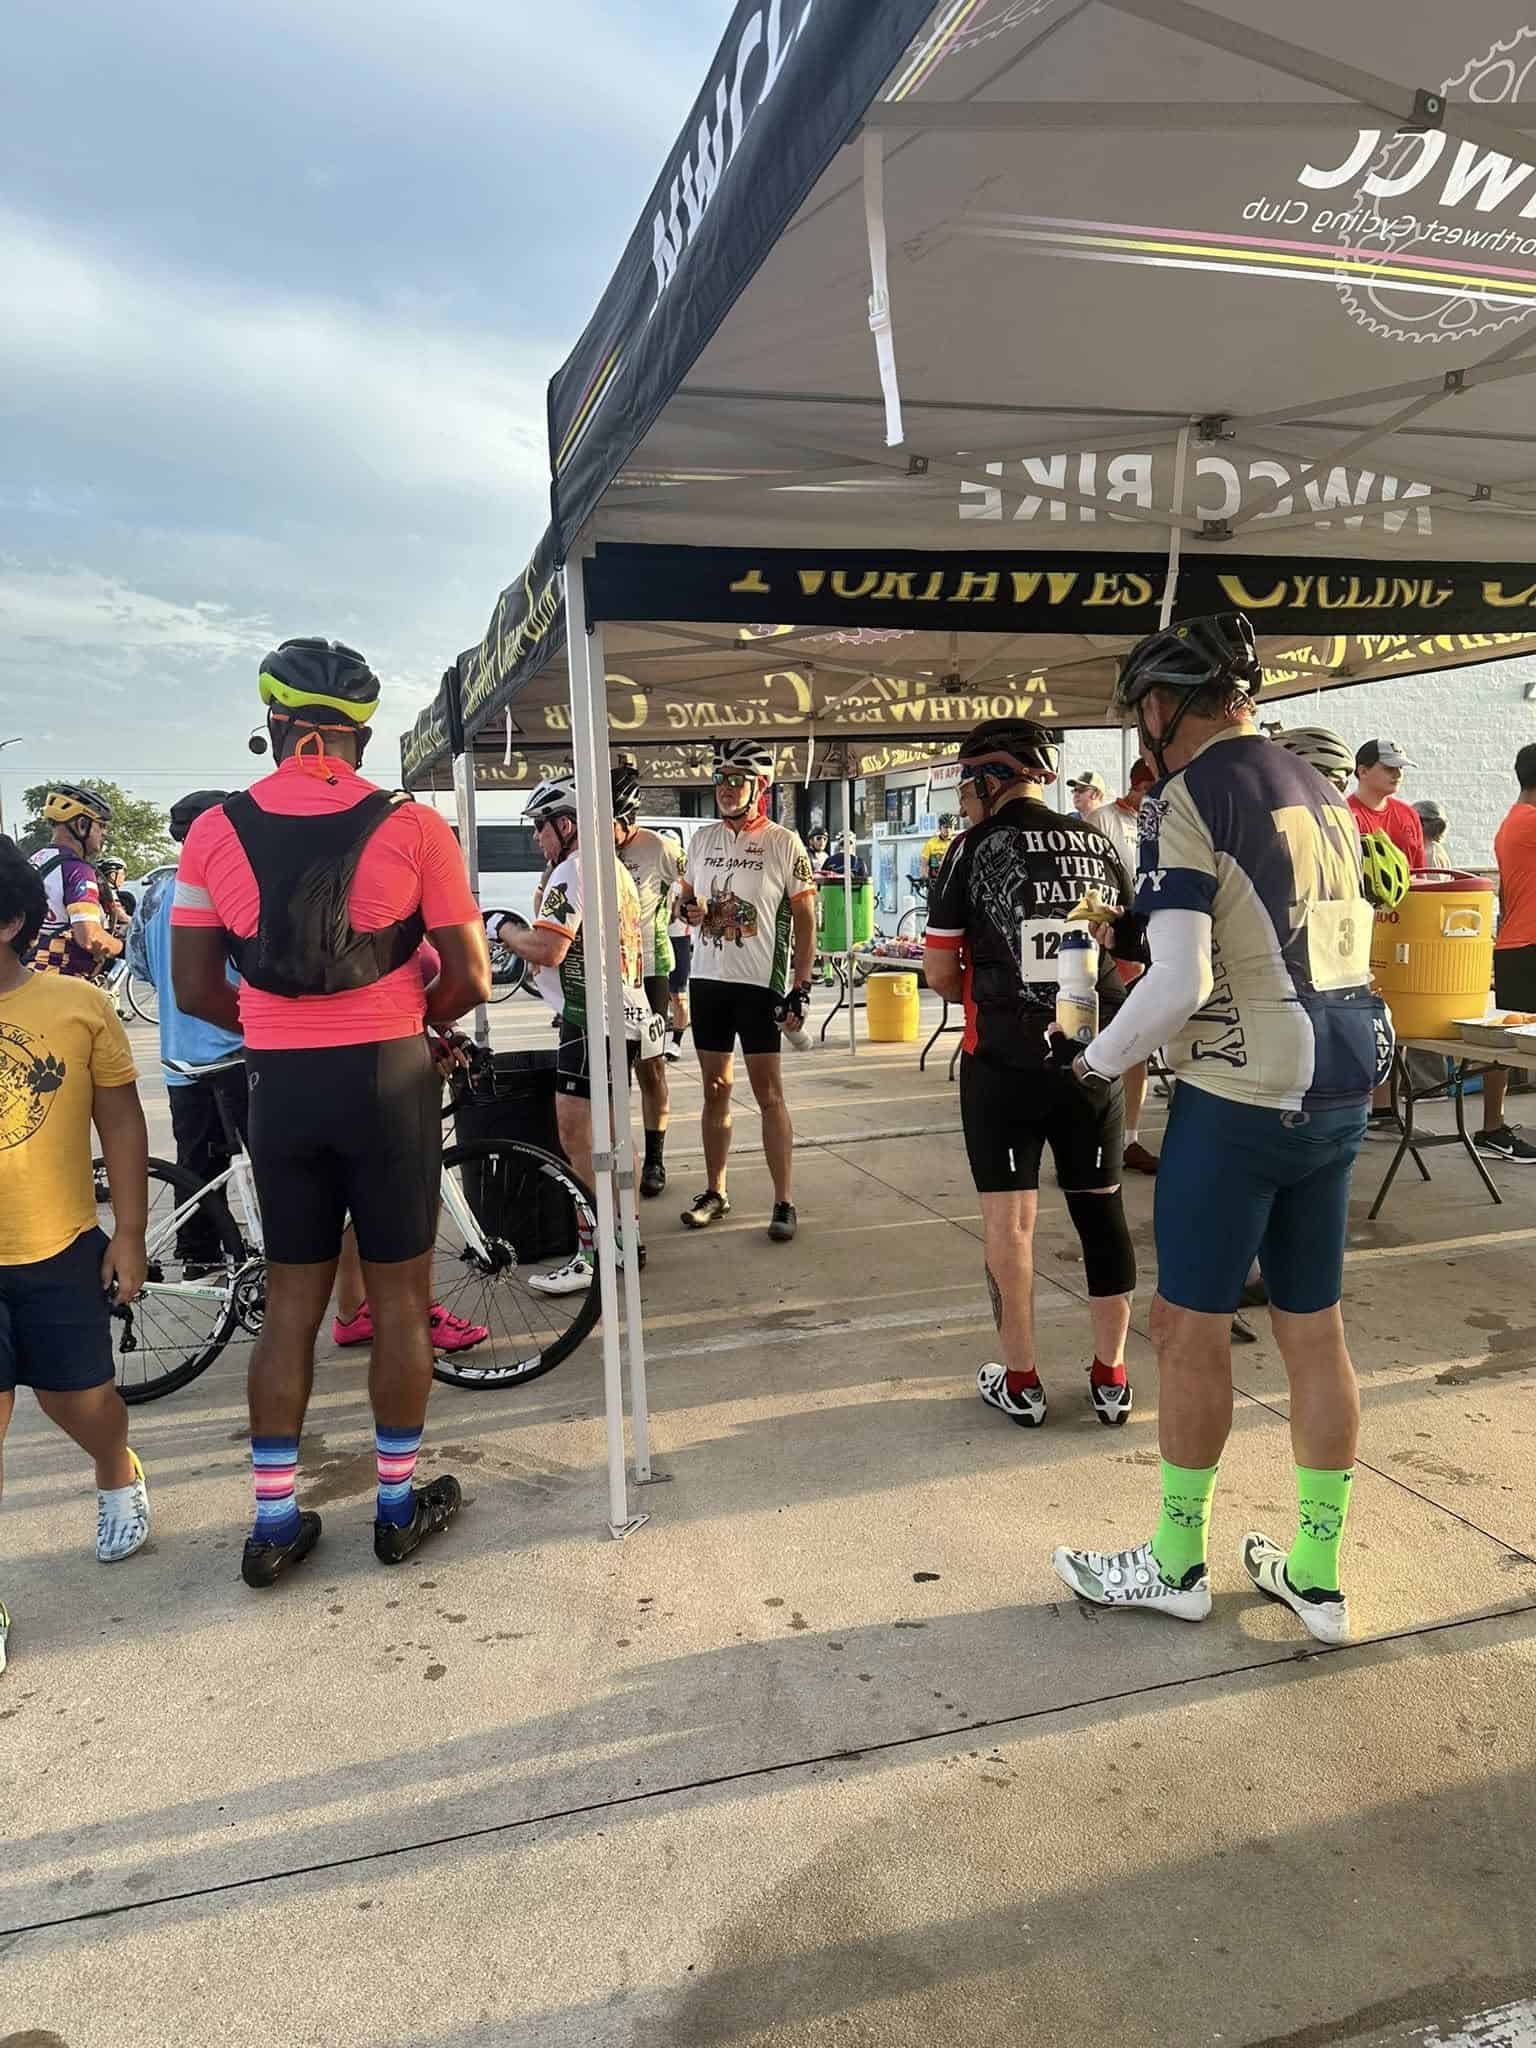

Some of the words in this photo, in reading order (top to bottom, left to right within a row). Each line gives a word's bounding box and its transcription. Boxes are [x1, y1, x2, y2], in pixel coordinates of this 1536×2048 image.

[704, 857, 724, 868] THE
[1055, 855, 1105, 881] THE
[1372, 1018, 1391, 1073] NAVY
